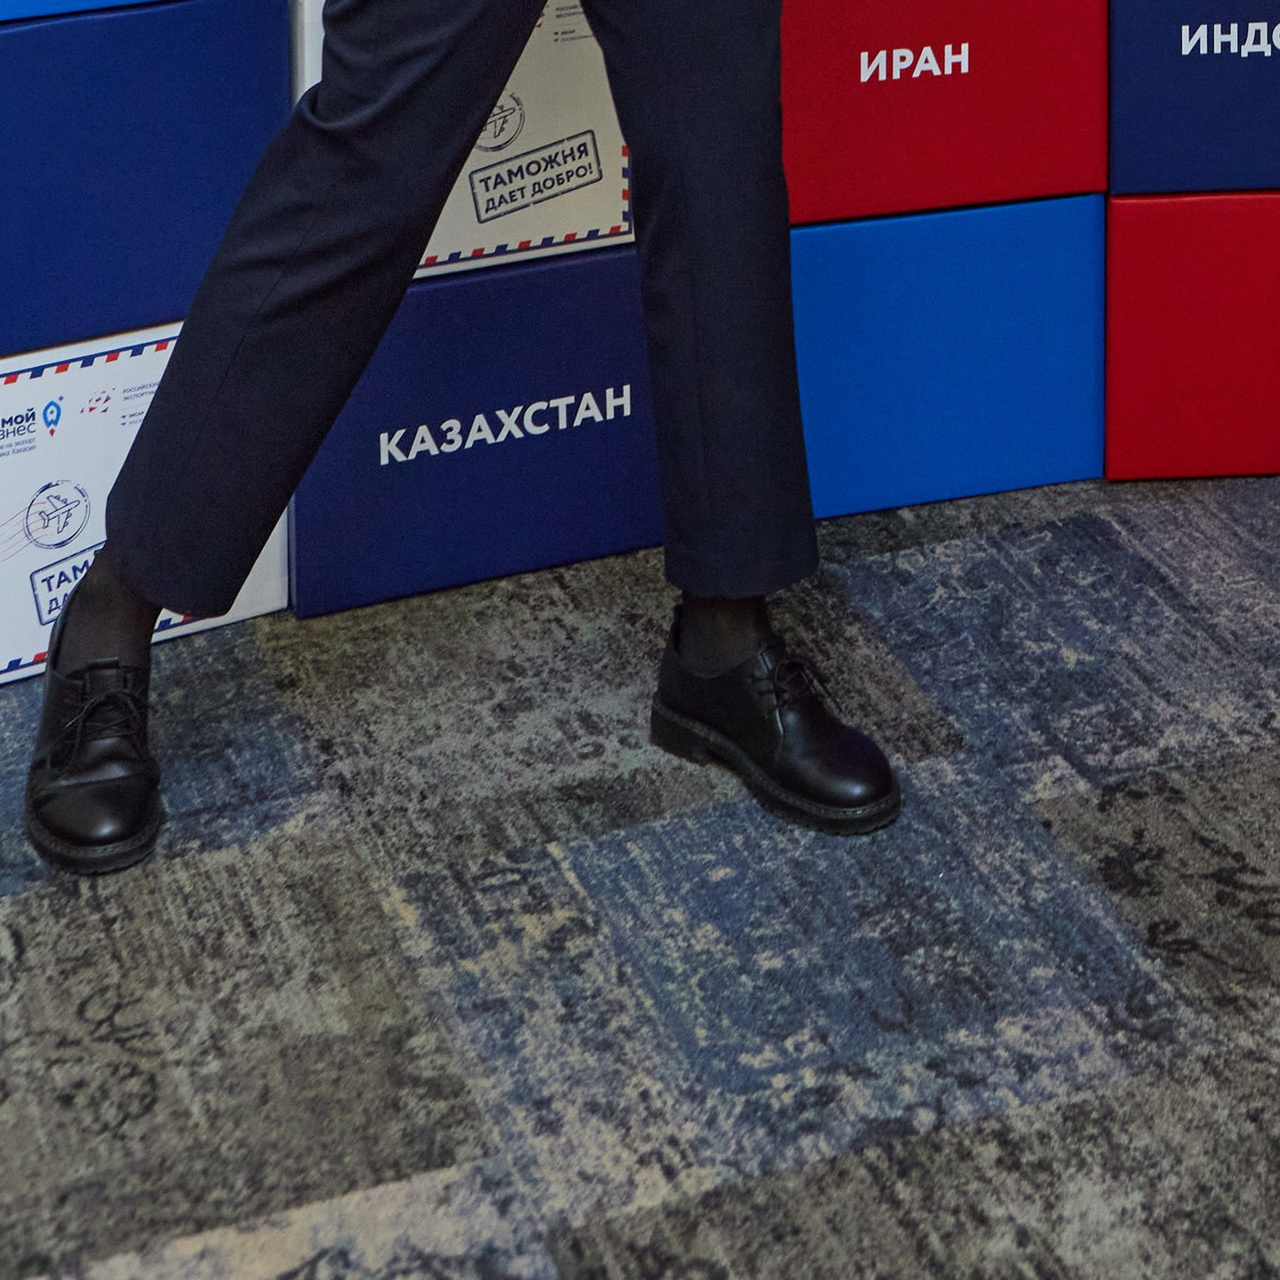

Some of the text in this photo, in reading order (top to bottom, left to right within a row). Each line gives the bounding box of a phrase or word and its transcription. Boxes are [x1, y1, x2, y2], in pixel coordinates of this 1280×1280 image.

[860, 43, 969, 82] ИРАН
[479, 142, 589, 192] ТАМОЖНЯ
[485, 163, 593, 214] ДАЕТ ДОБРО!
[0, 422, 36, 440] знес
[379, 384, 631, 466] КАЗАХСТАН
